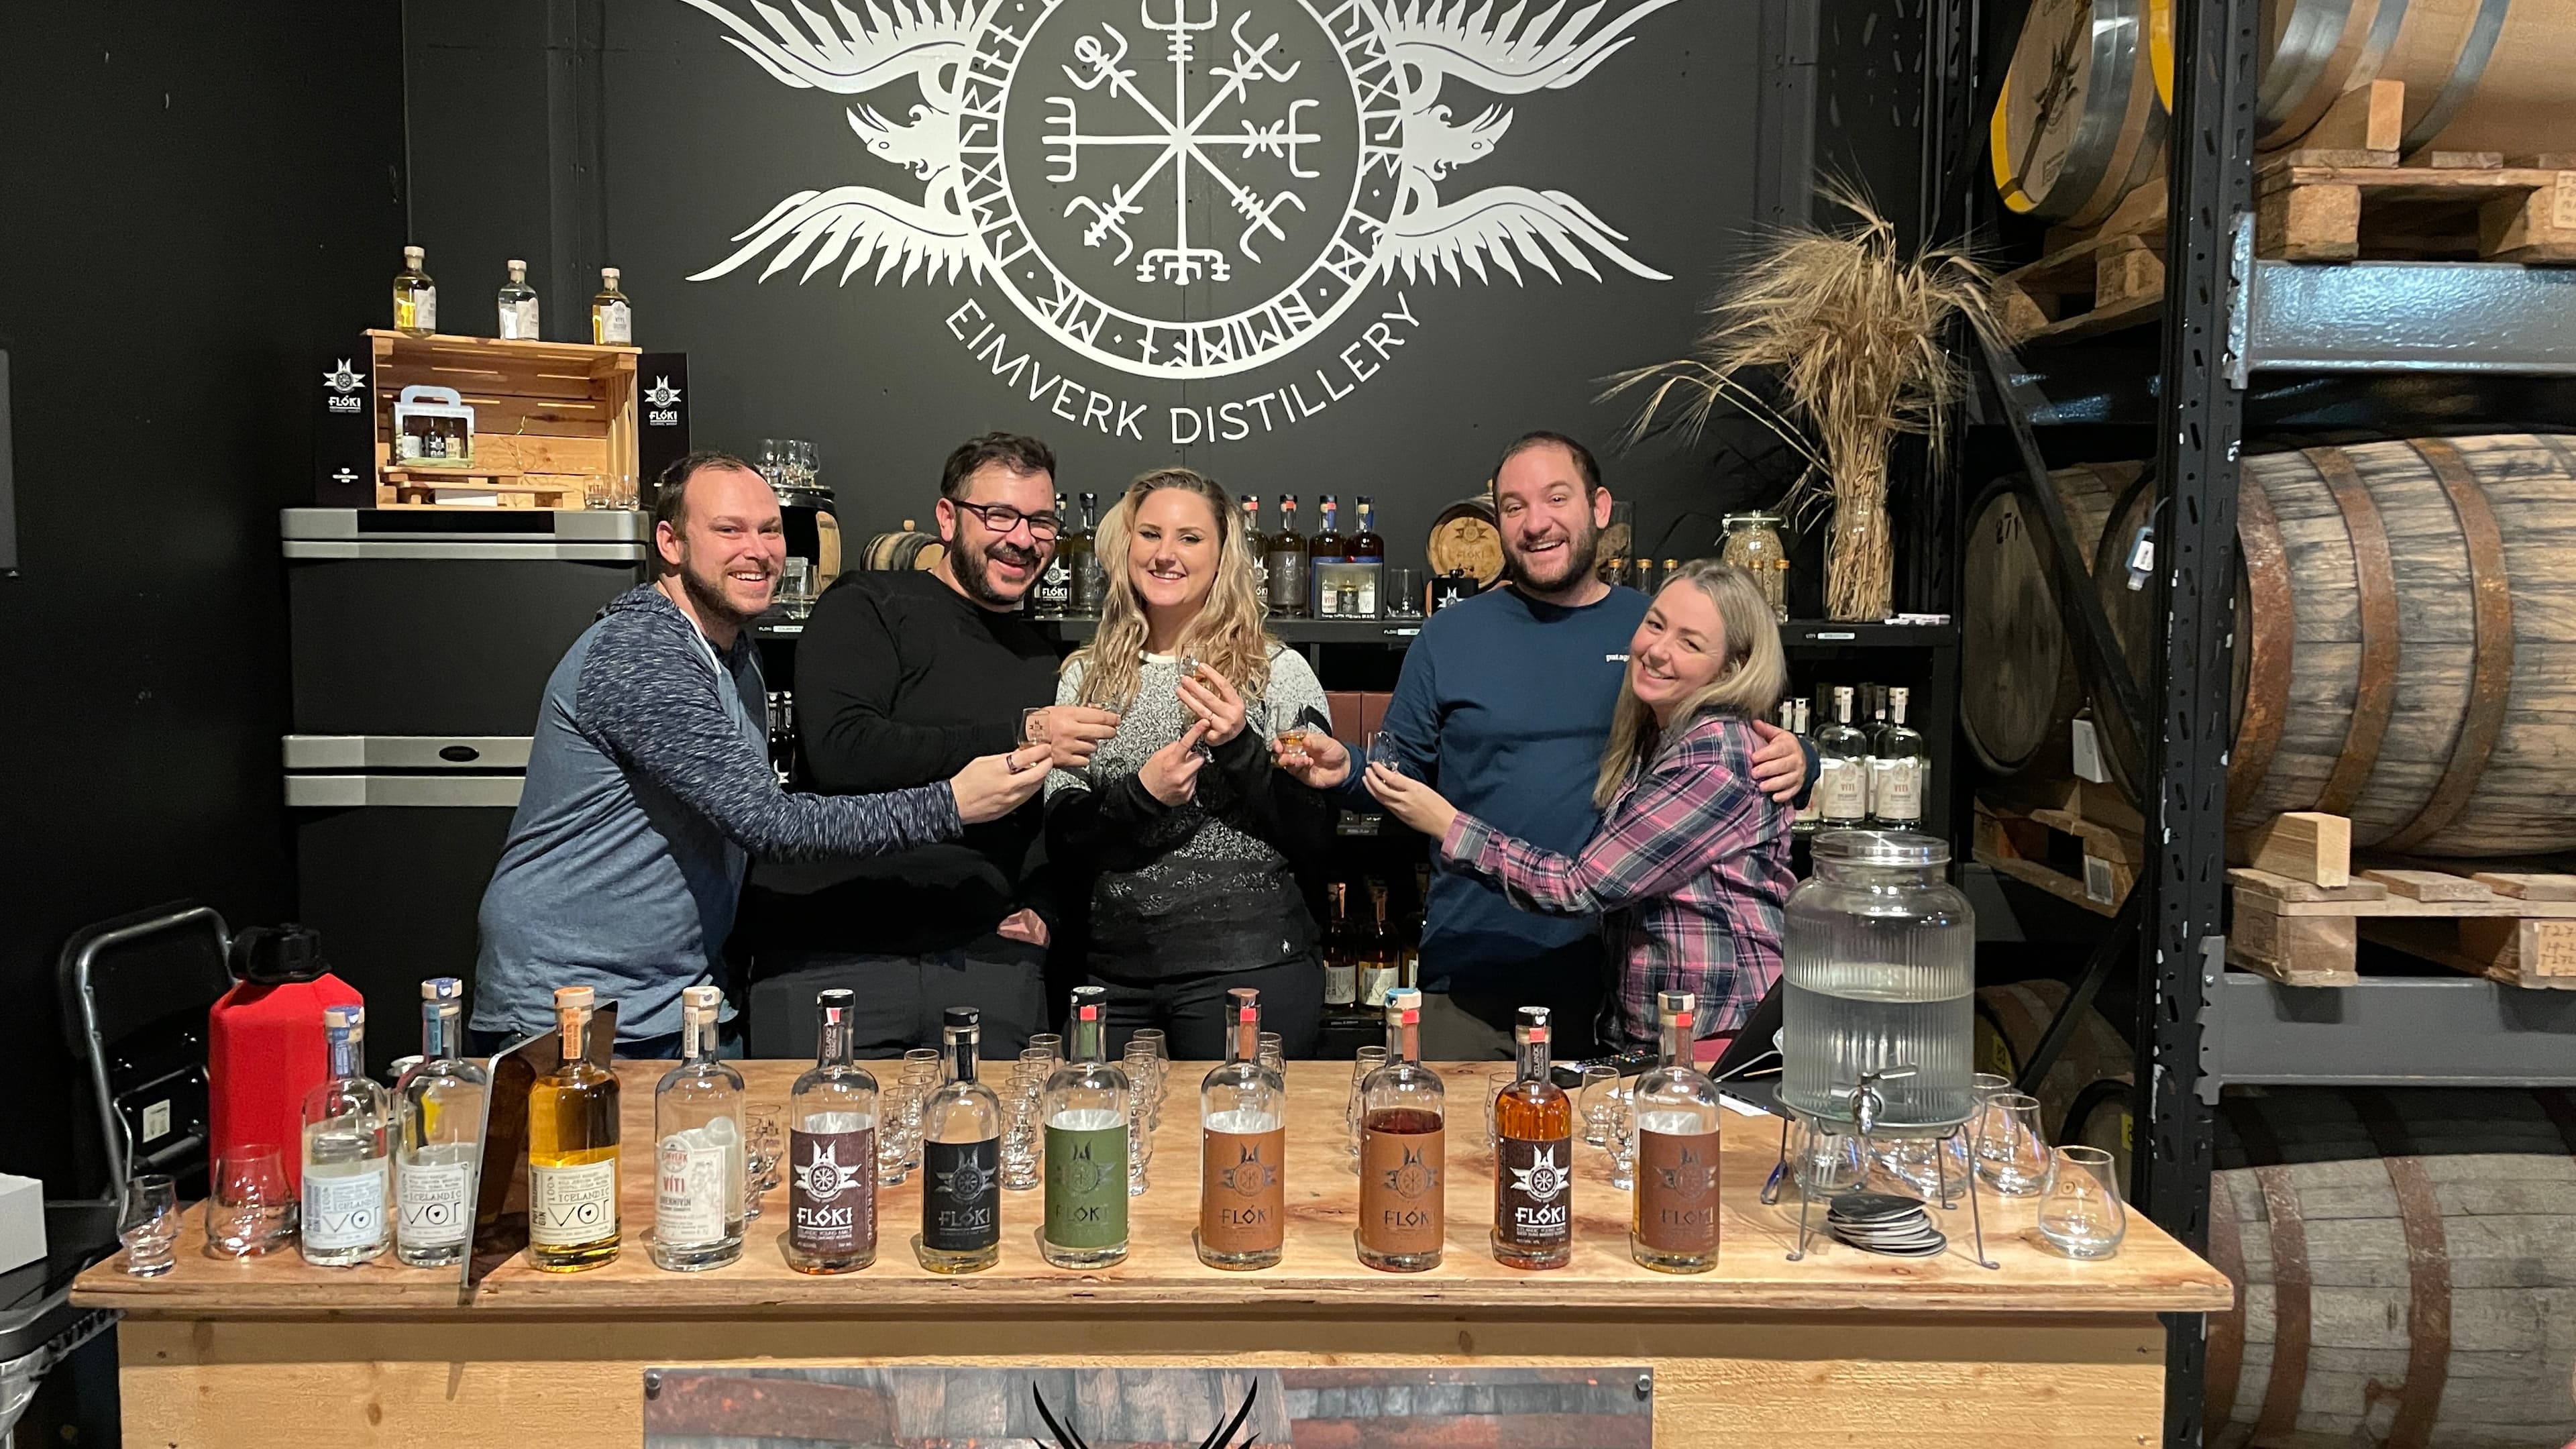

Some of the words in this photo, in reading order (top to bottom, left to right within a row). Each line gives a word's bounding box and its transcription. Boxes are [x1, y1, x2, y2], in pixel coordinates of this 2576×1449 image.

[945, 298, 1148, 441] EIMVERK
[1171, 291, 1420, 444] DISTILLERY
[328, 394, 361, 407] FLÓKI
[649, 409, 678, 420] FLÓKI
[1042, 586, 1067, 596] FLÓKI
[663, 1175, 685, 1192] VÍTI
[410, 1190, 462, 1201] ICELANDIC
[559, 1187, 610, 1203] ICELANDIC
[796, 1204, 853, 1227] FLÓKI
[938, 1205, 990, 1227] FLÓKI
[1515, 1203, 1566, 1224] FLÓKI
